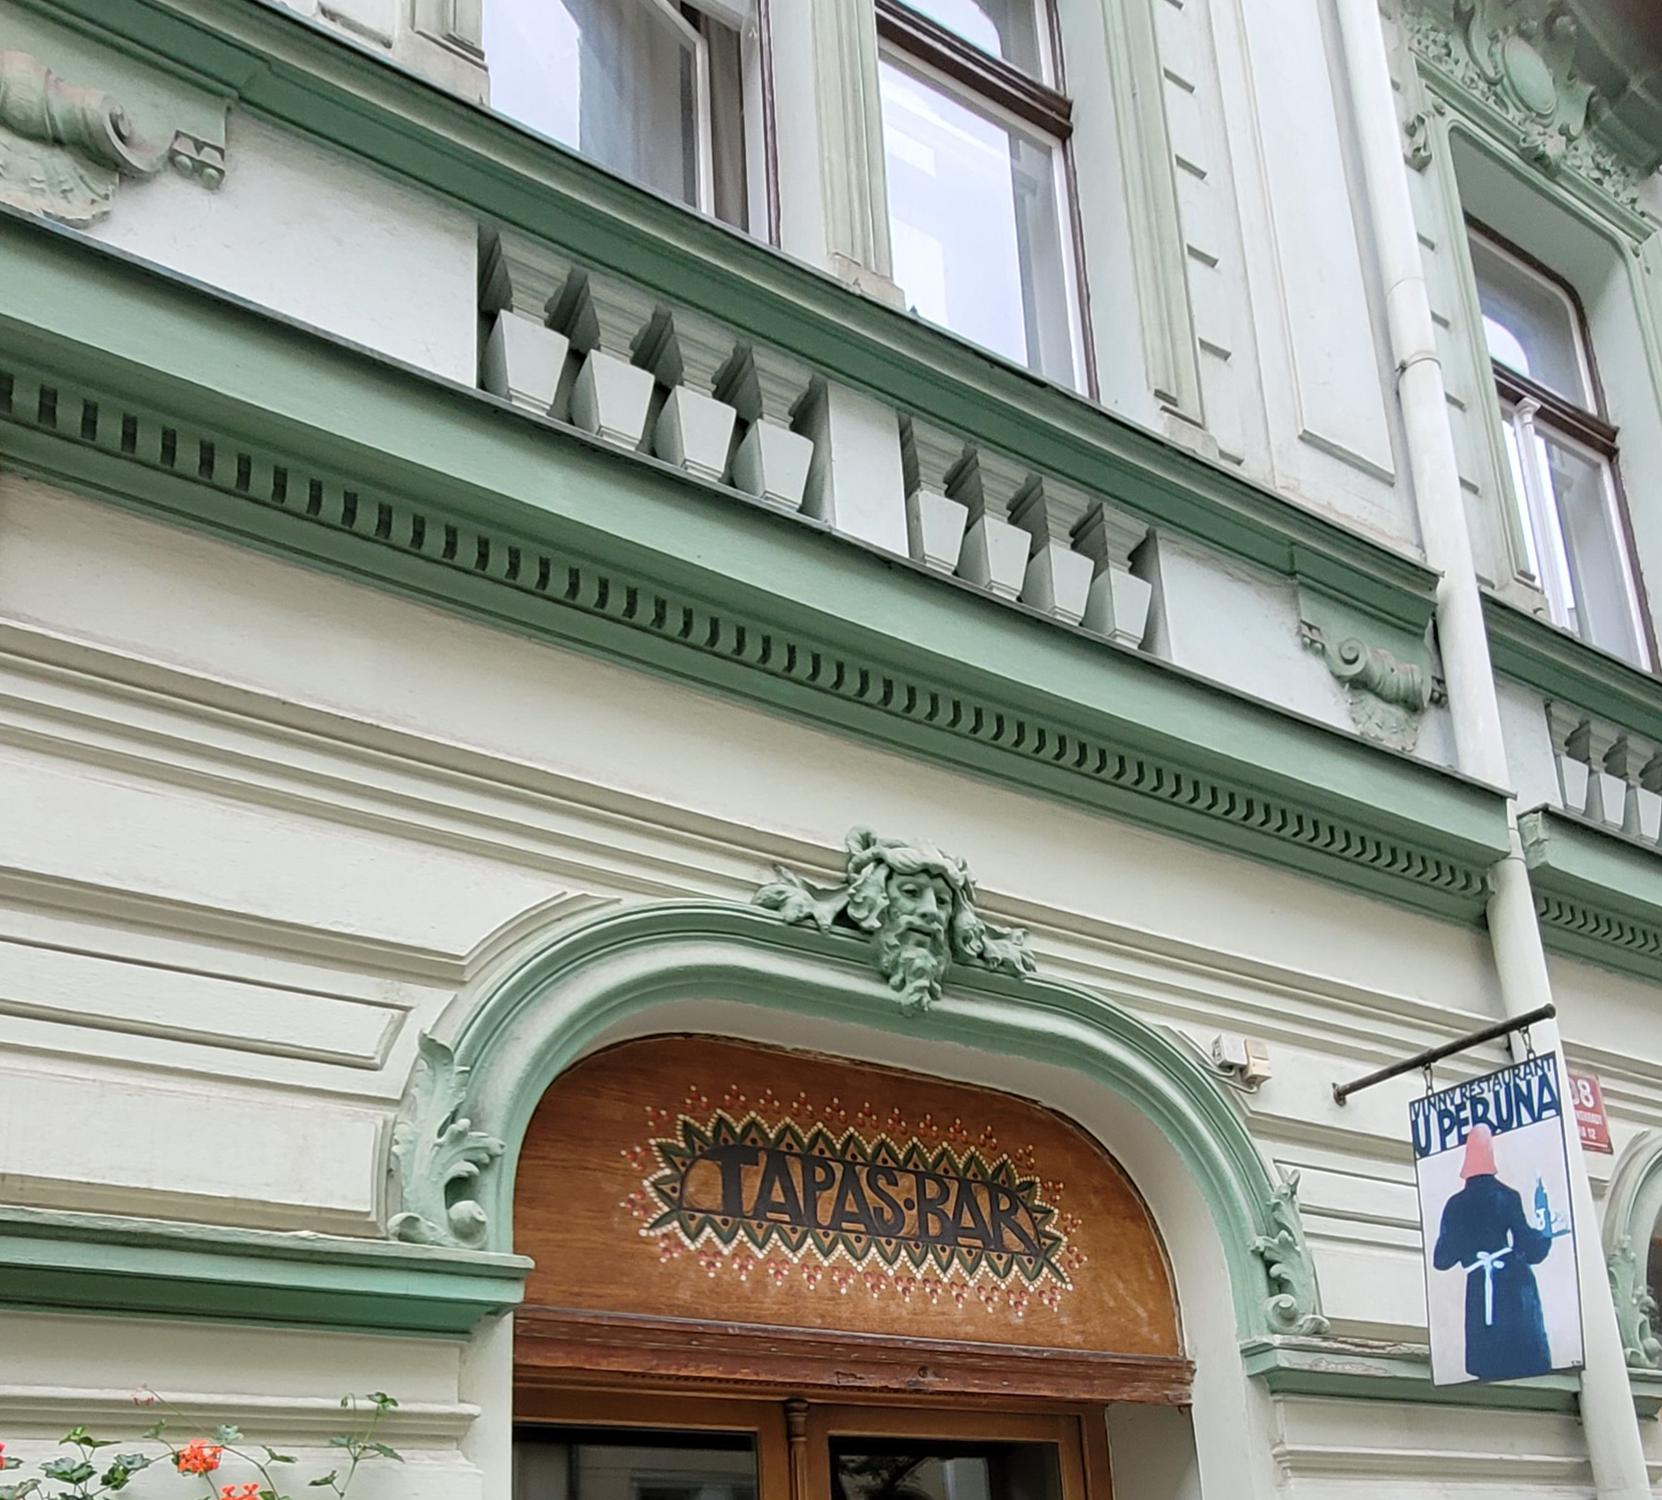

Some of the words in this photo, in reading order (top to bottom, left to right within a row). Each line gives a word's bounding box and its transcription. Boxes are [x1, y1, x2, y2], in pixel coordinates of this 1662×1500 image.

[1458, 1055, 1555, 1101] RESTAURANT
[1411, 1117, 1432, 1157] U
[1436, 1073, 1561, 1152] PERUNA
